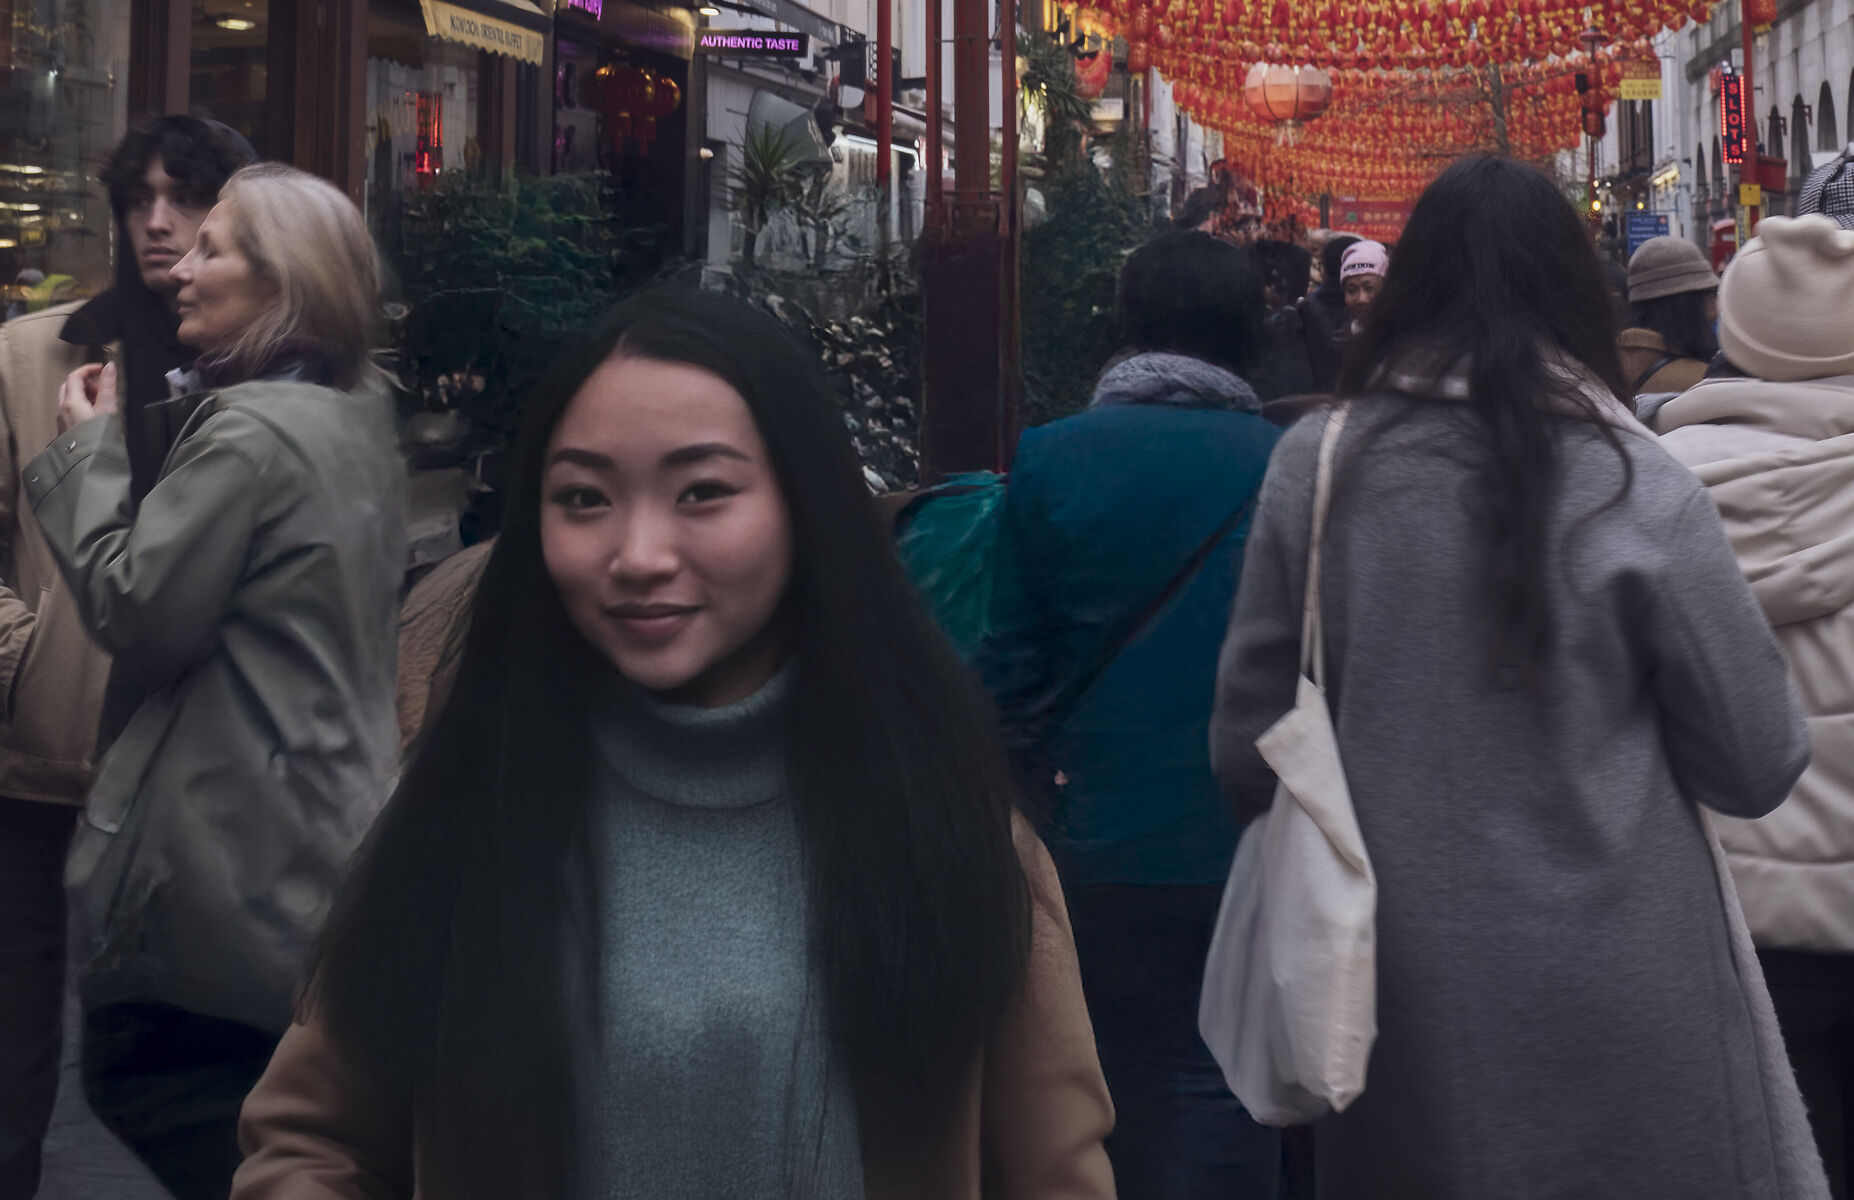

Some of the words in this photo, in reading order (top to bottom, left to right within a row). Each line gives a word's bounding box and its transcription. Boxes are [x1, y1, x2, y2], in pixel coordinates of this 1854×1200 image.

[700, 34, 763, 50] AUTHENTIC
[765, 37, 800, 51] TASTE
[1727, 82, 1741, 156] SLOTS
